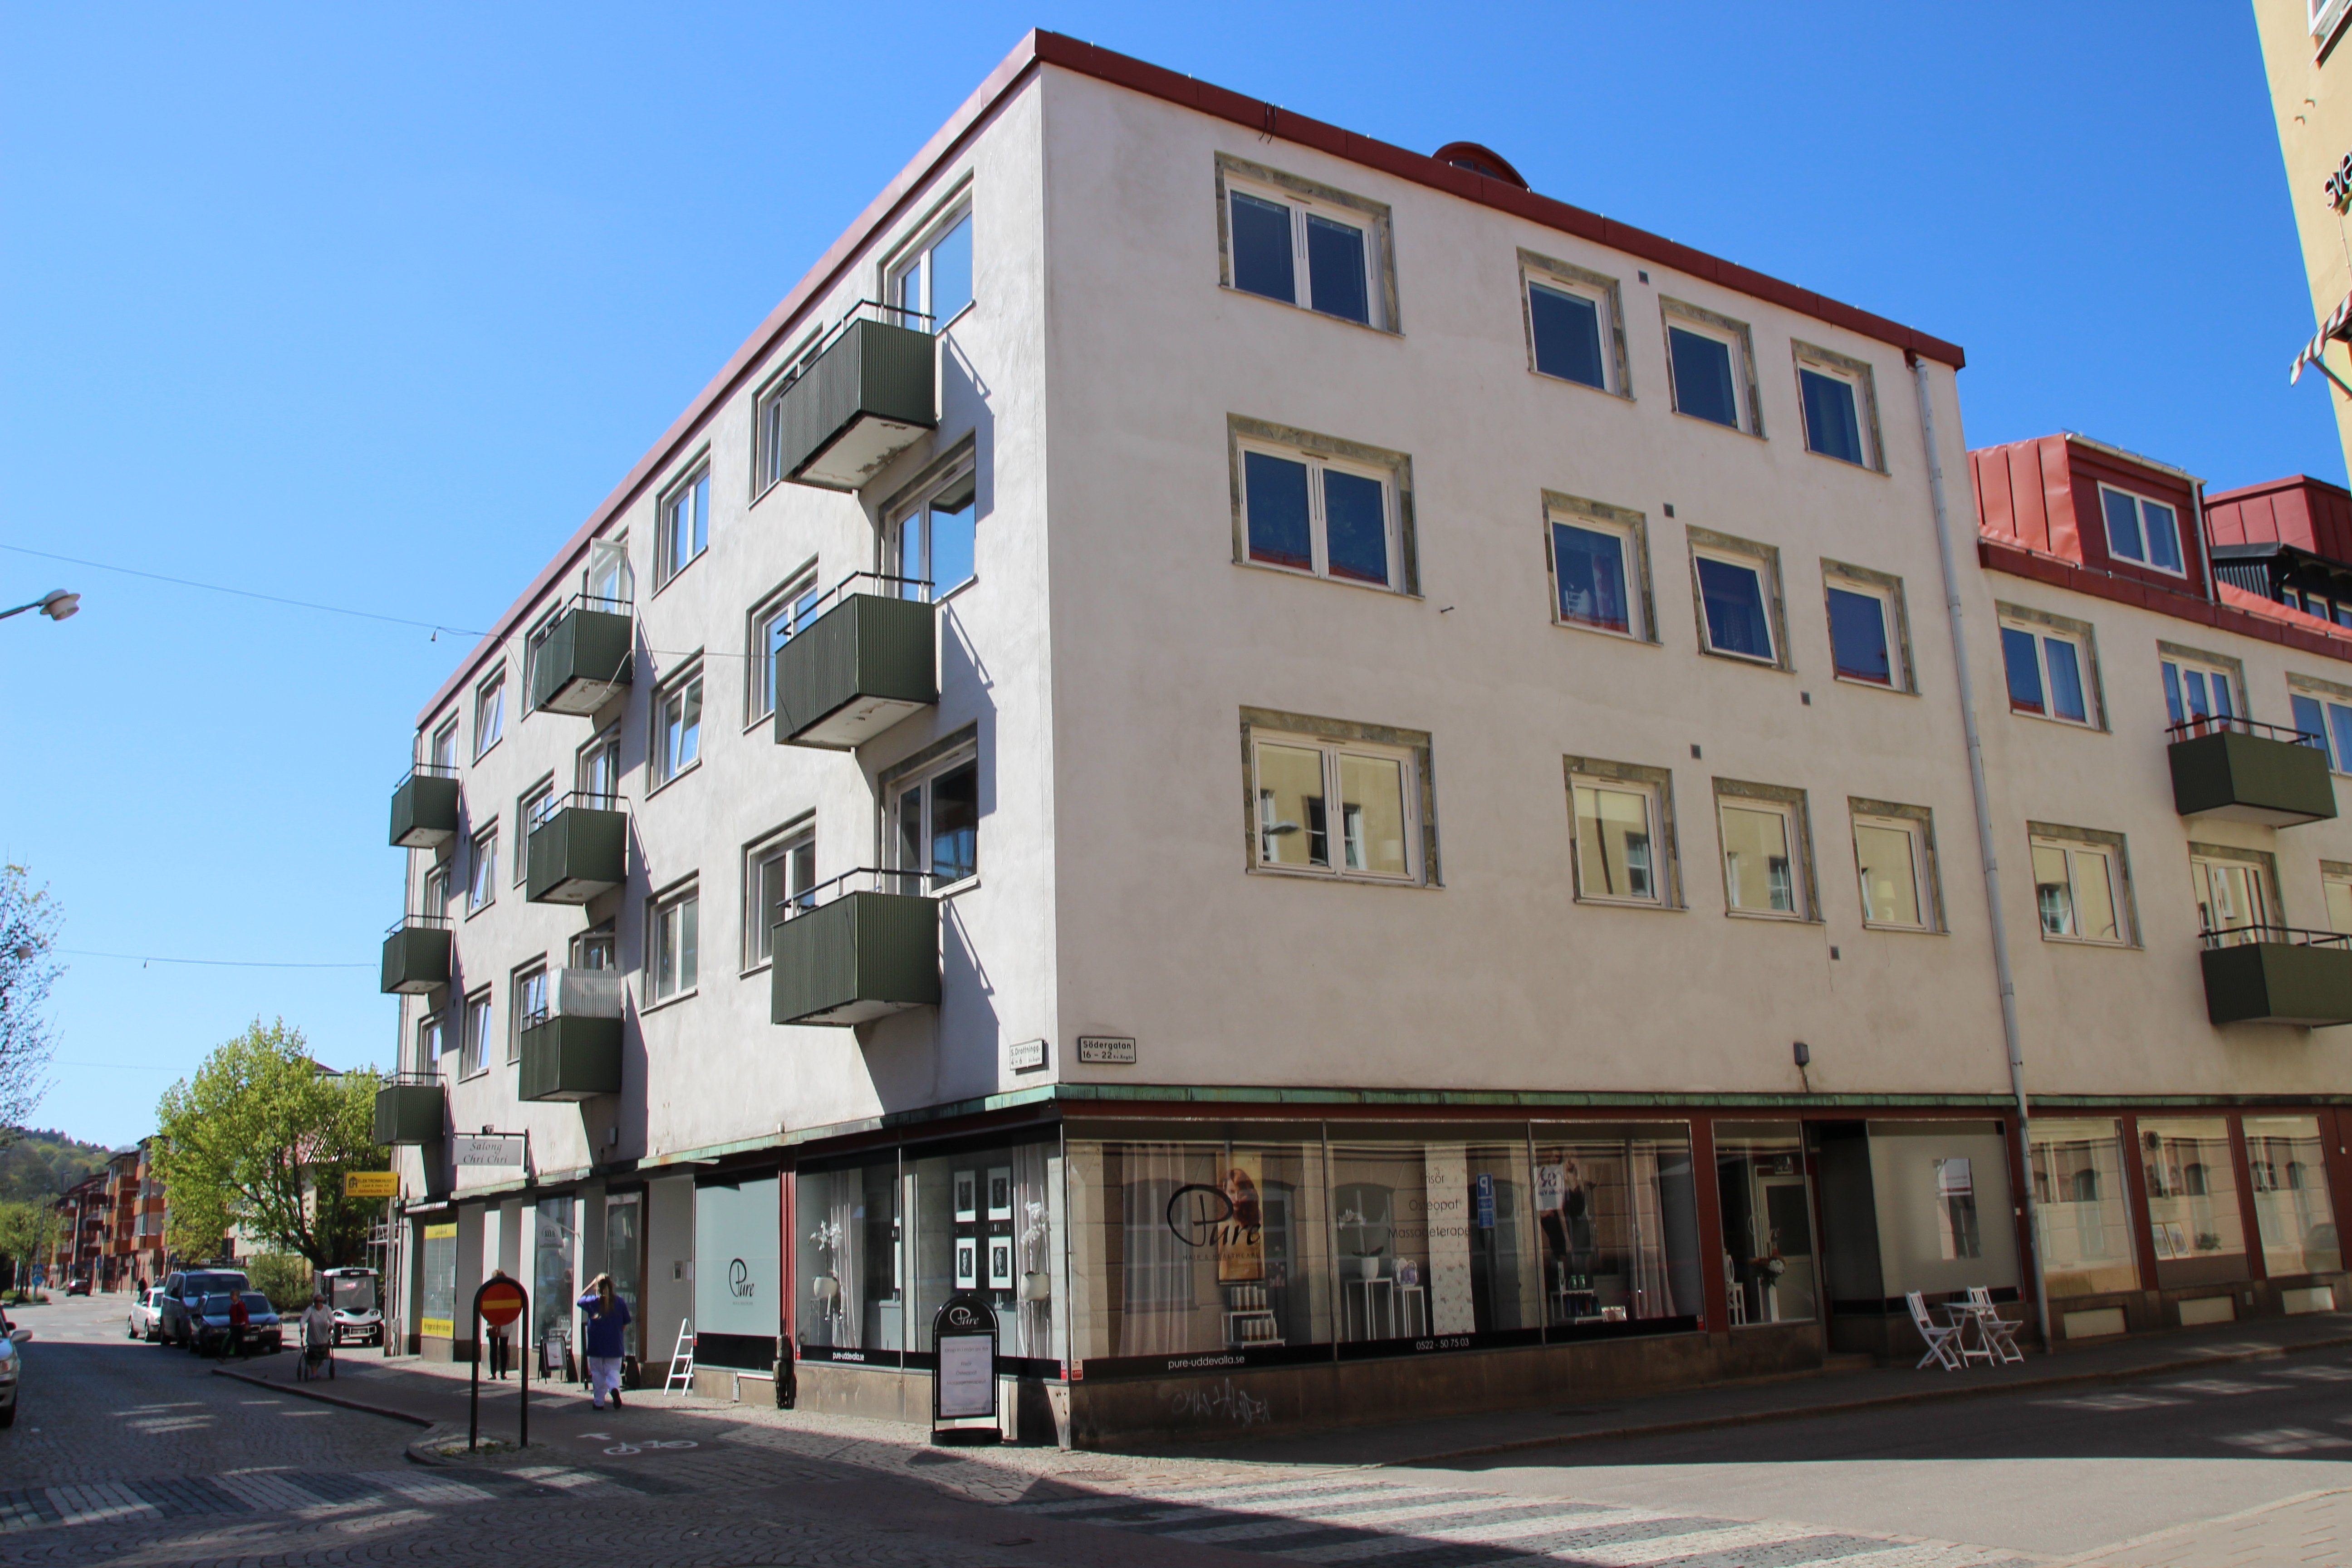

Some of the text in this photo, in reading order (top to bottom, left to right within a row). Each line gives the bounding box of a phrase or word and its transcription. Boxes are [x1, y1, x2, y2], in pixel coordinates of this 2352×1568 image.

[2323, 146, 2352, 210] sve
[1083, 1040, 1131, 1051] Södergatan
[1019, 1056, 1022, 1064] 6
[1083, 1050, 1091, 1058] 16
[1102, 1051, 1112, 1059] 22
[470, 1141, 502, 1154] Salong
[463, 1154, 508, 1164] Chri Chri
[1420, 1172, 1445, 1184] Frisör
[1409, 1198, 1458, 1212] Osteopat
[1167, 1184, 1261, 1247] Pure
[1388, 1225, 1471, 1240] Massageterape
[729, 1258, 754, 1298] Pure
[950, 1307, 979, 1326] Pure
[1416, 1340, 1434, 1350] 0522
[1440, 1338, 1449, 1348] 50
[1450, 1338, 1459, 1347] 75
[1460, 1338, 1469, 1347] 03
[833, 1351, 864, 1362] pure-uddevalla.se
[1168, 1355, 1245, 1370] pure-uddevalla.se
